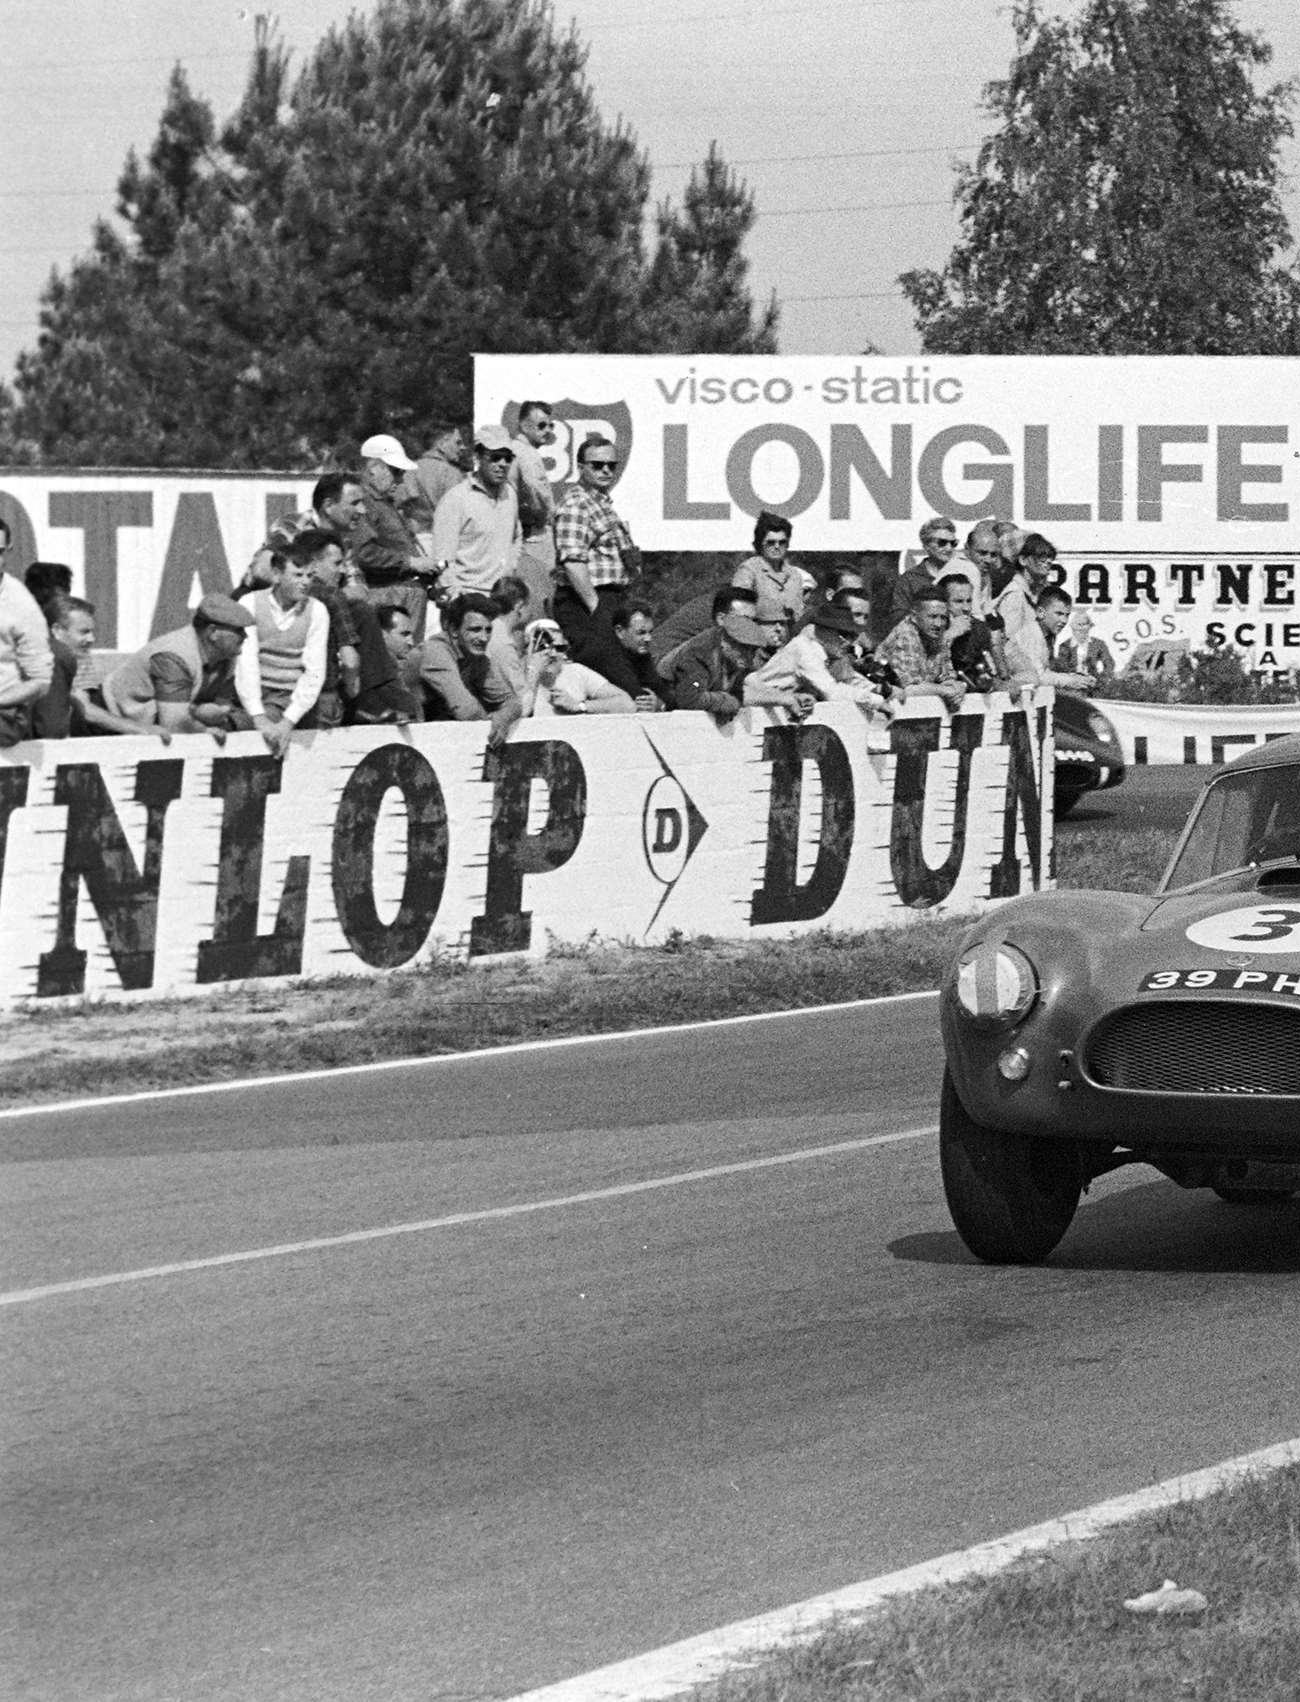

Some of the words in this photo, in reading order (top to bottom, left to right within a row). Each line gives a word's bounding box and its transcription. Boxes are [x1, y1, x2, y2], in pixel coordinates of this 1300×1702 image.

[662, 423, 1290, 522] LONGLIFE
[652, 807, 683, 854] D
[1147, 970, 1218, 989] 39
